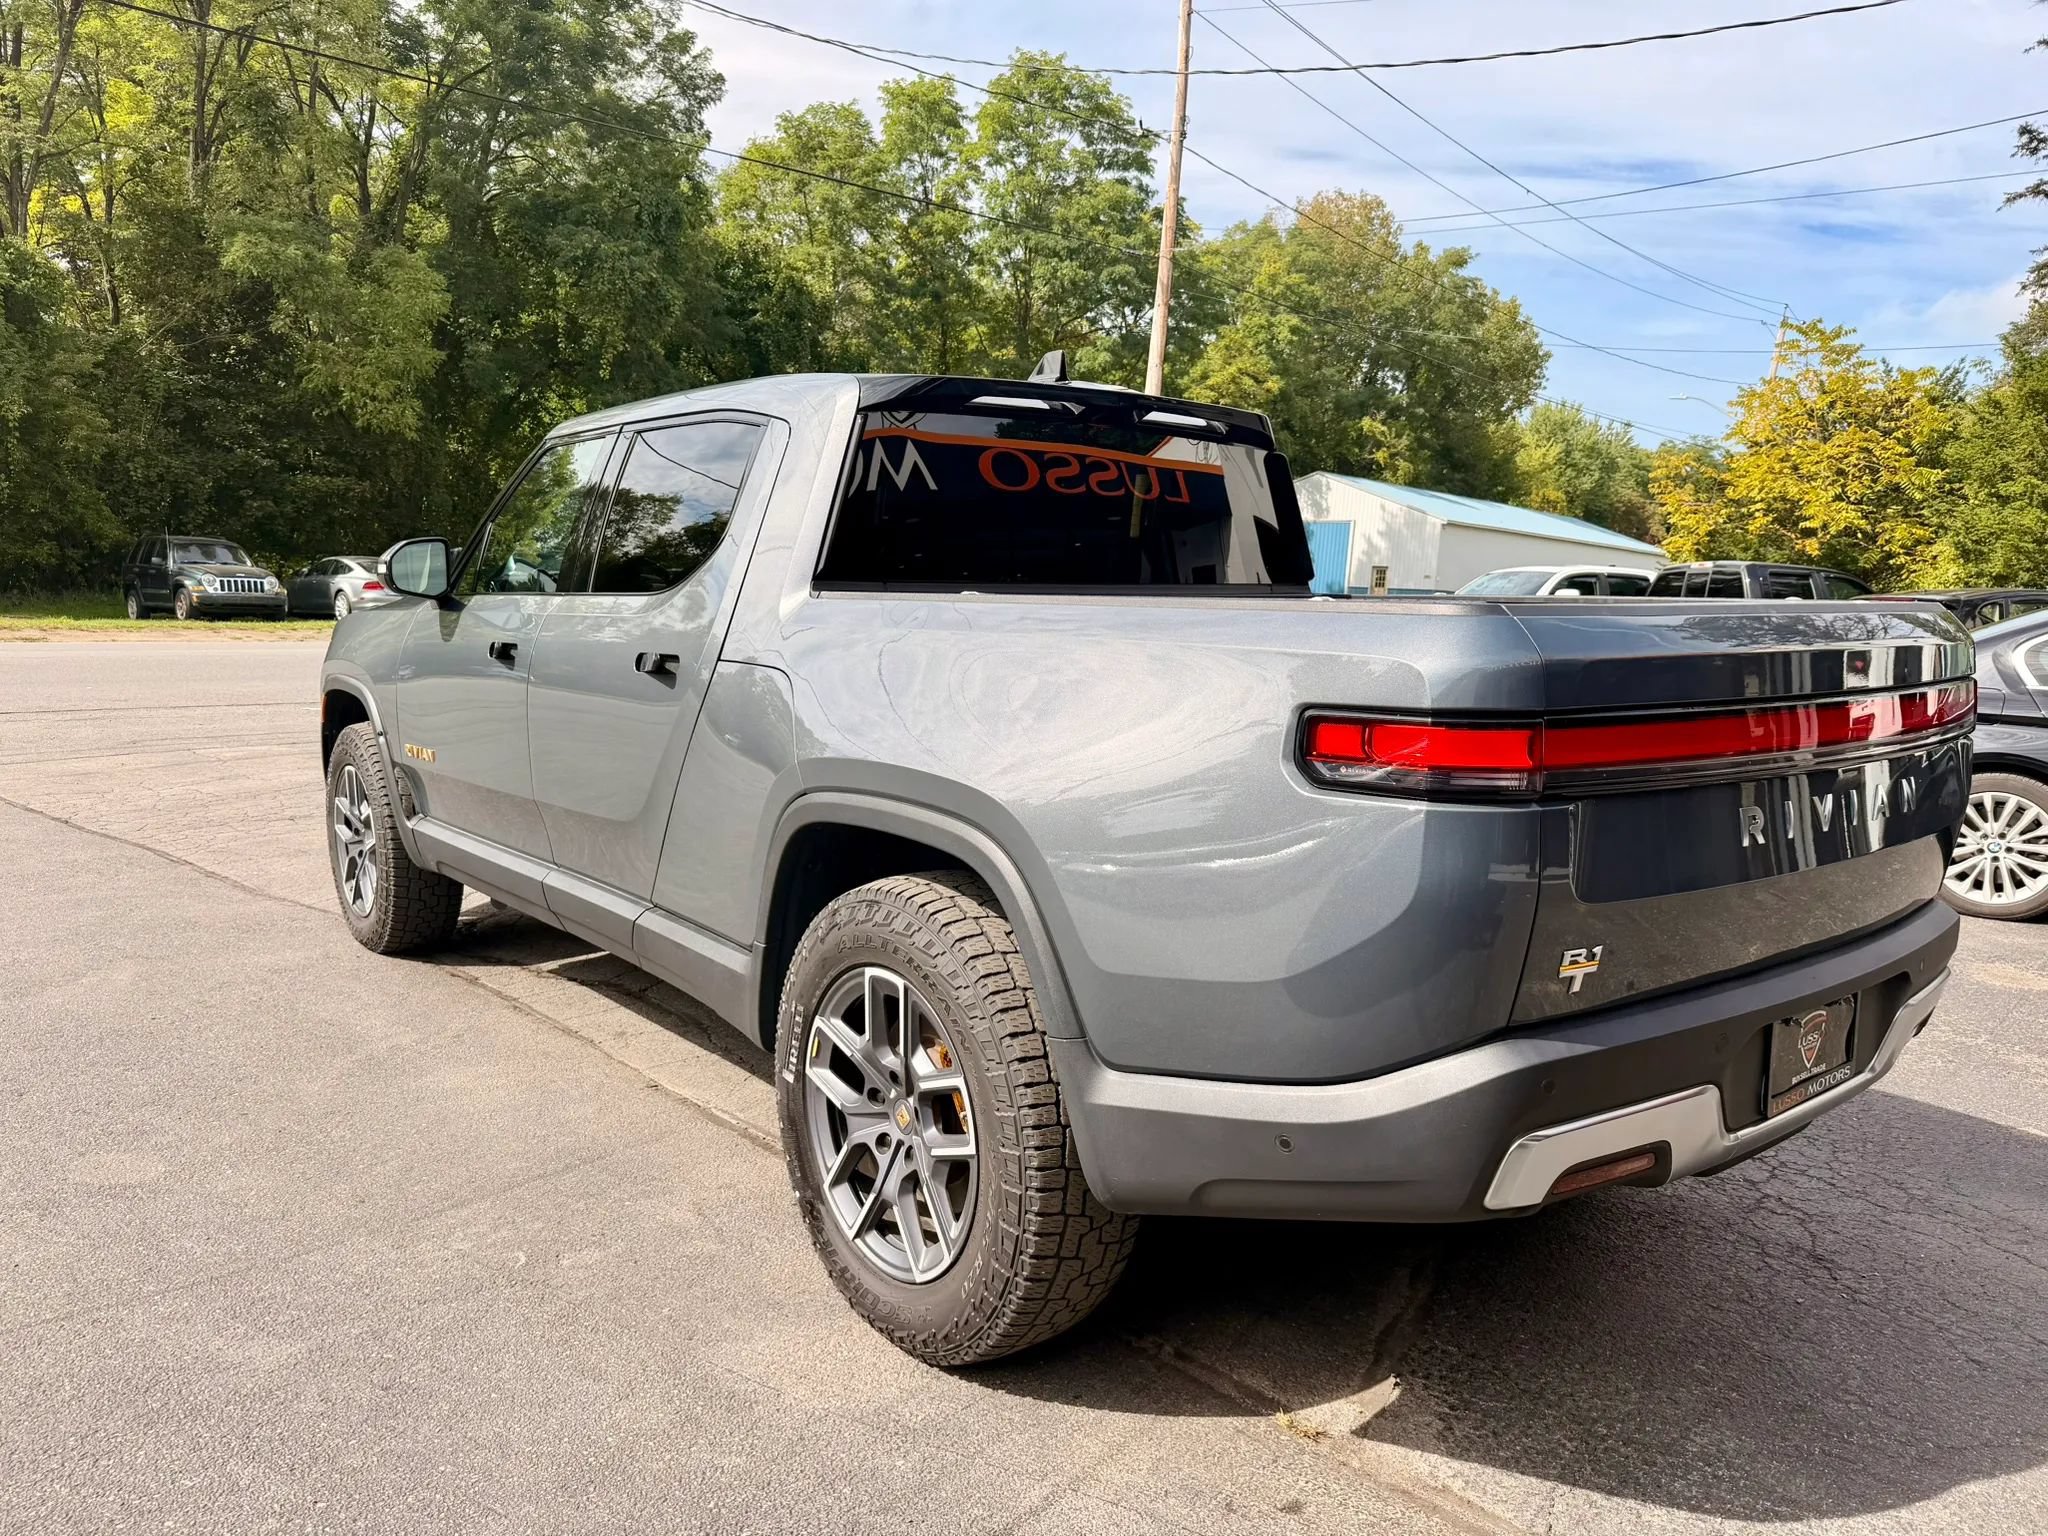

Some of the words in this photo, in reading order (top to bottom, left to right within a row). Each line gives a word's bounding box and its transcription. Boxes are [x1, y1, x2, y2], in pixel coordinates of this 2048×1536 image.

[1739, 776, 1916, 848] RIVIAN
[782, 1000, 804, 1083] PIRELLI
[1772, 1088, 1805, 1112] LUSSO
[1807, 1065, 1851, 1096] MOTORS
